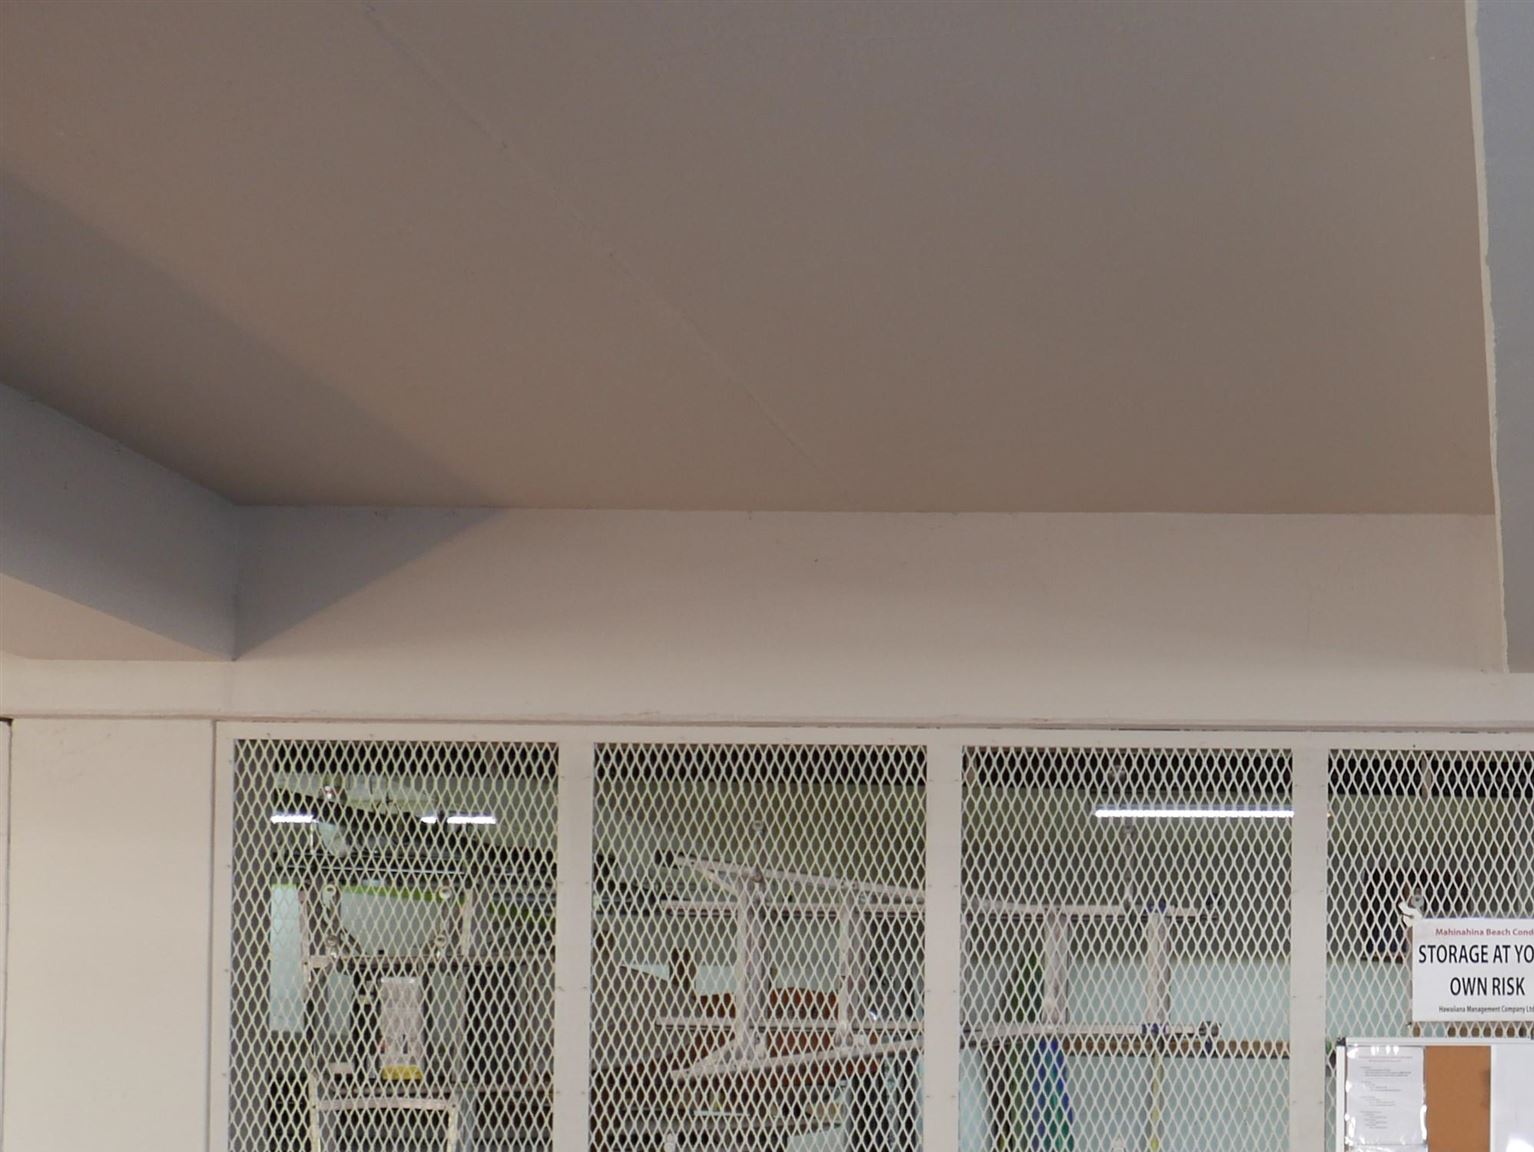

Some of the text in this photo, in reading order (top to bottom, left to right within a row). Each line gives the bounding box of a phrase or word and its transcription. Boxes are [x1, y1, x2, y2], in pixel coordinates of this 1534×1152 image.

[1435, 928, 1484, 936] Mahinahina
[1486, 928, 1511, 936] Beach
[1418, 944, 1489, 964] STORAGE
[1492, 944, 1511, 963] AT
[1450, 976, 1525, 996] OWN RISK
[1466, 1005, 1501, 1014] Management
[1501, 1005, 1525, 1014] Company
